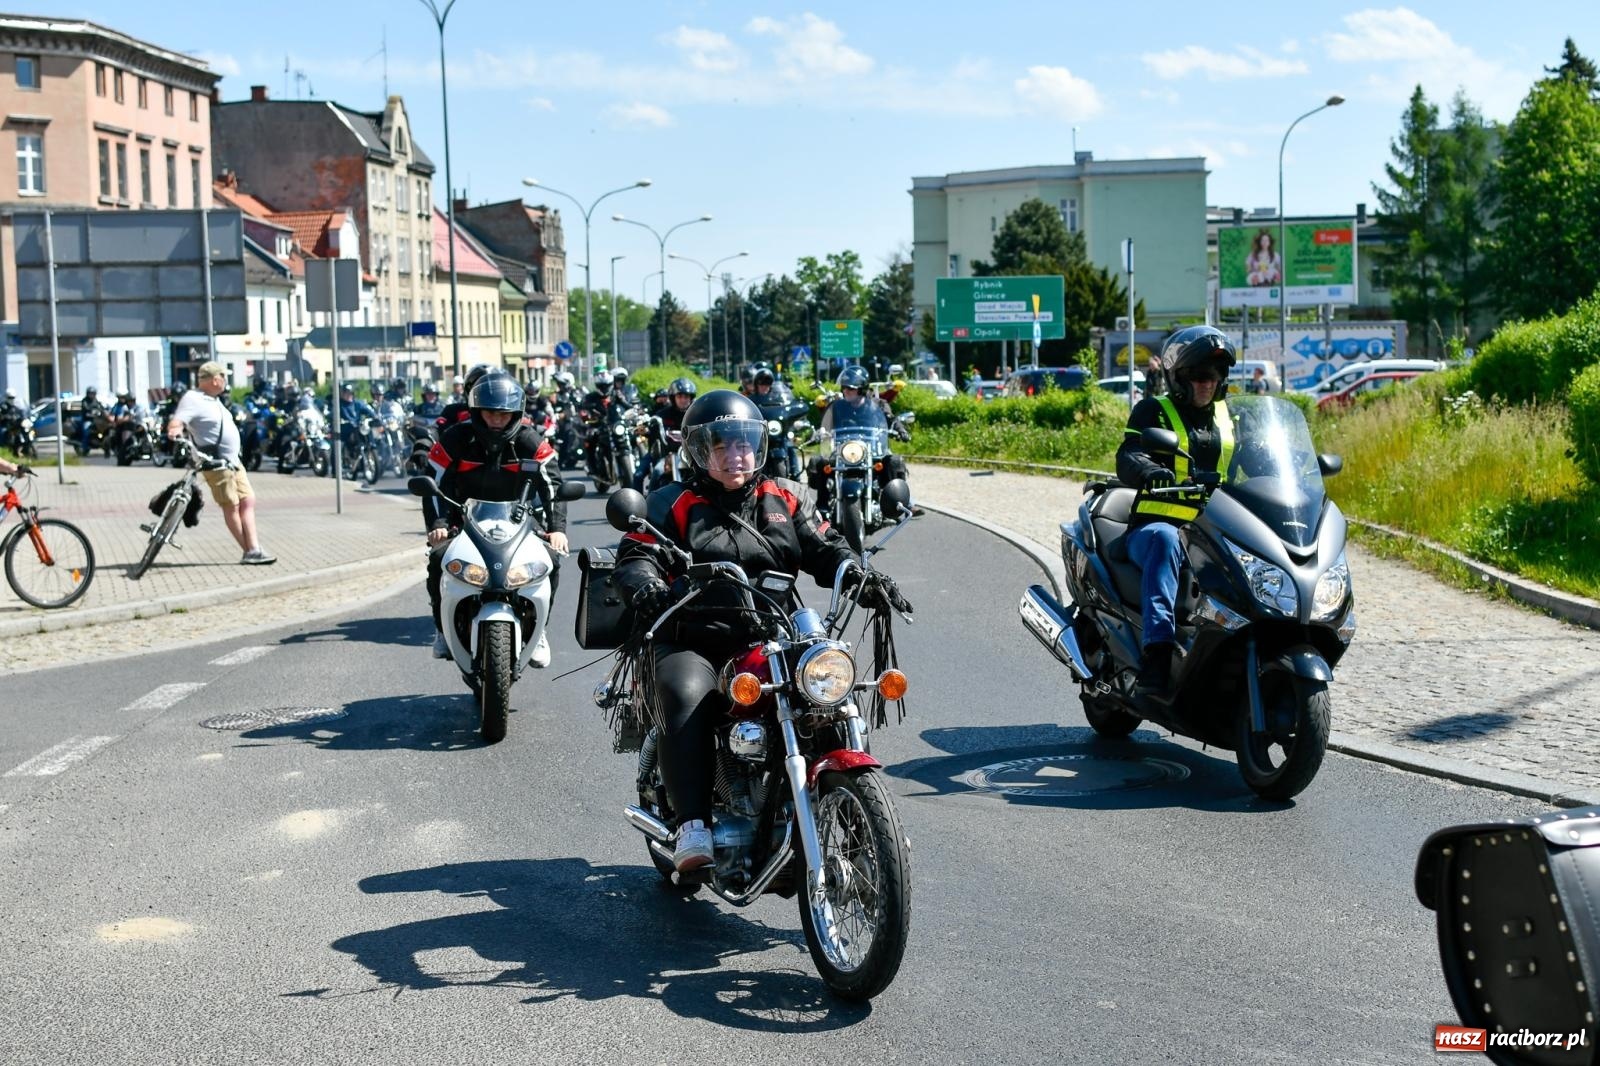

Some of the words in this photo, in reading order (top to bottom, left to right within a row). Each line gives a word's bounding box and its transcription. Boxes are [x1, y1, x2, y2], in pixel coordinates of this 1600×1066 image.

[974, 281, 1002, 290] Rybnik
[973, 291, 1006, 300] Gliwice
[974, 328, 1001, 337] Opole
